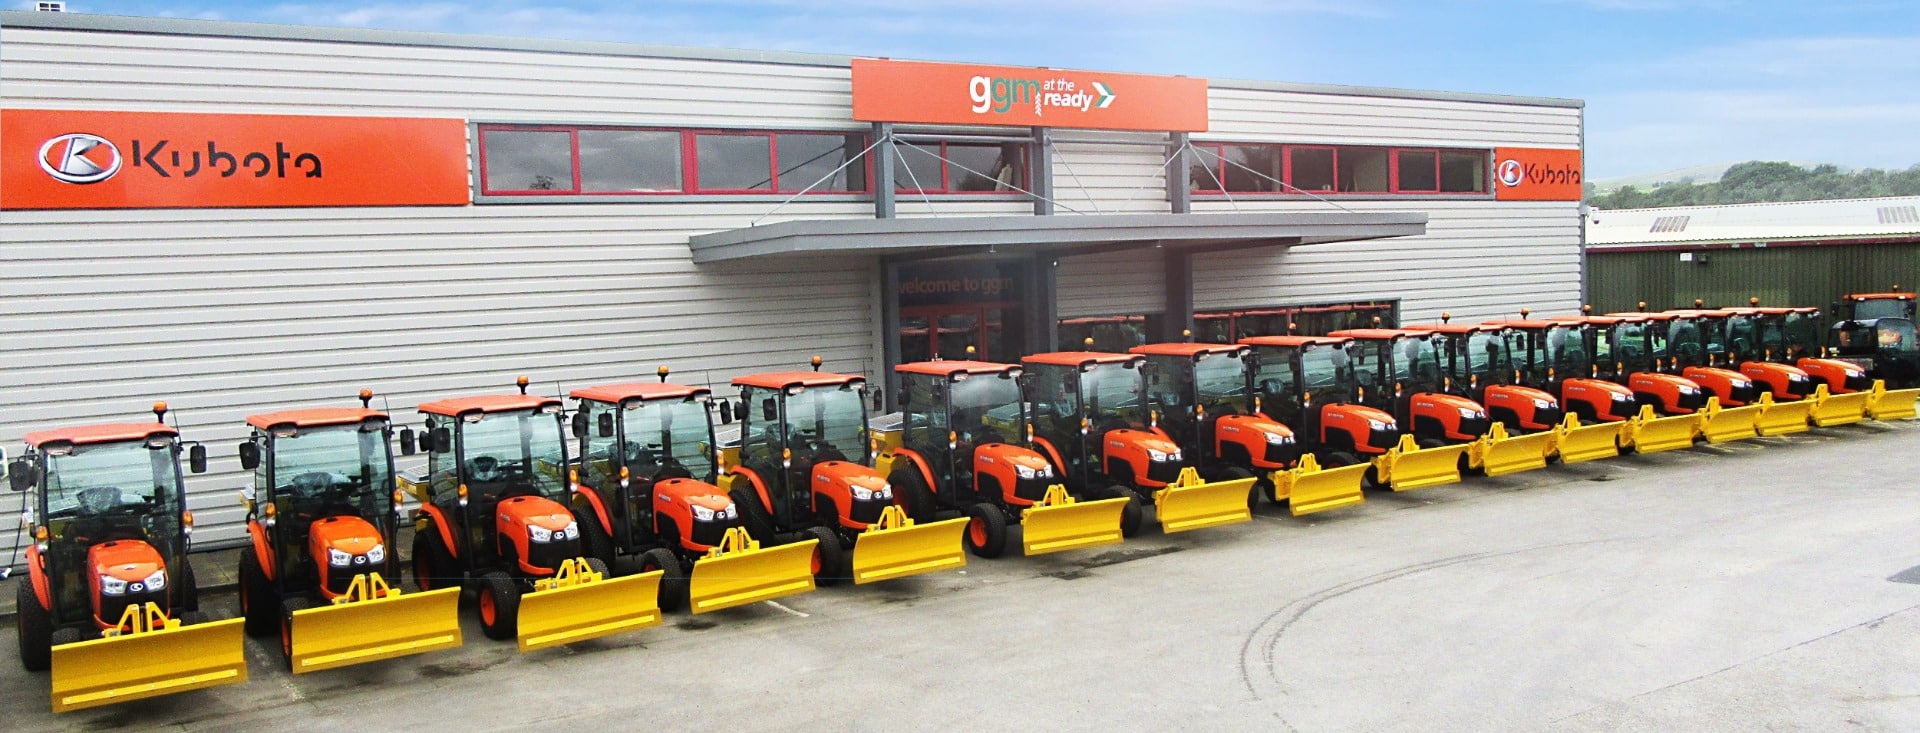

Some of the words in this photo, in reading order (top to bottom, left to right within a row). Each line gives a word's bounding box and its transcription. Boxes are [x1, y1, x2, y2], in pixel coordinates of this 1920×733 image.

[969, 75, 1040, 114] ggm
[1043, 79, 1056, 91] at
[1057, 78, 1075, 92] the
[1044, 89, 1093, 112] ready
[132, 139, 323, 178] Kubota
[1524, 162, 1580, 184] Kubota
[964, 277, 979, 291] to
[982, 277, 1013, 295] ggm
